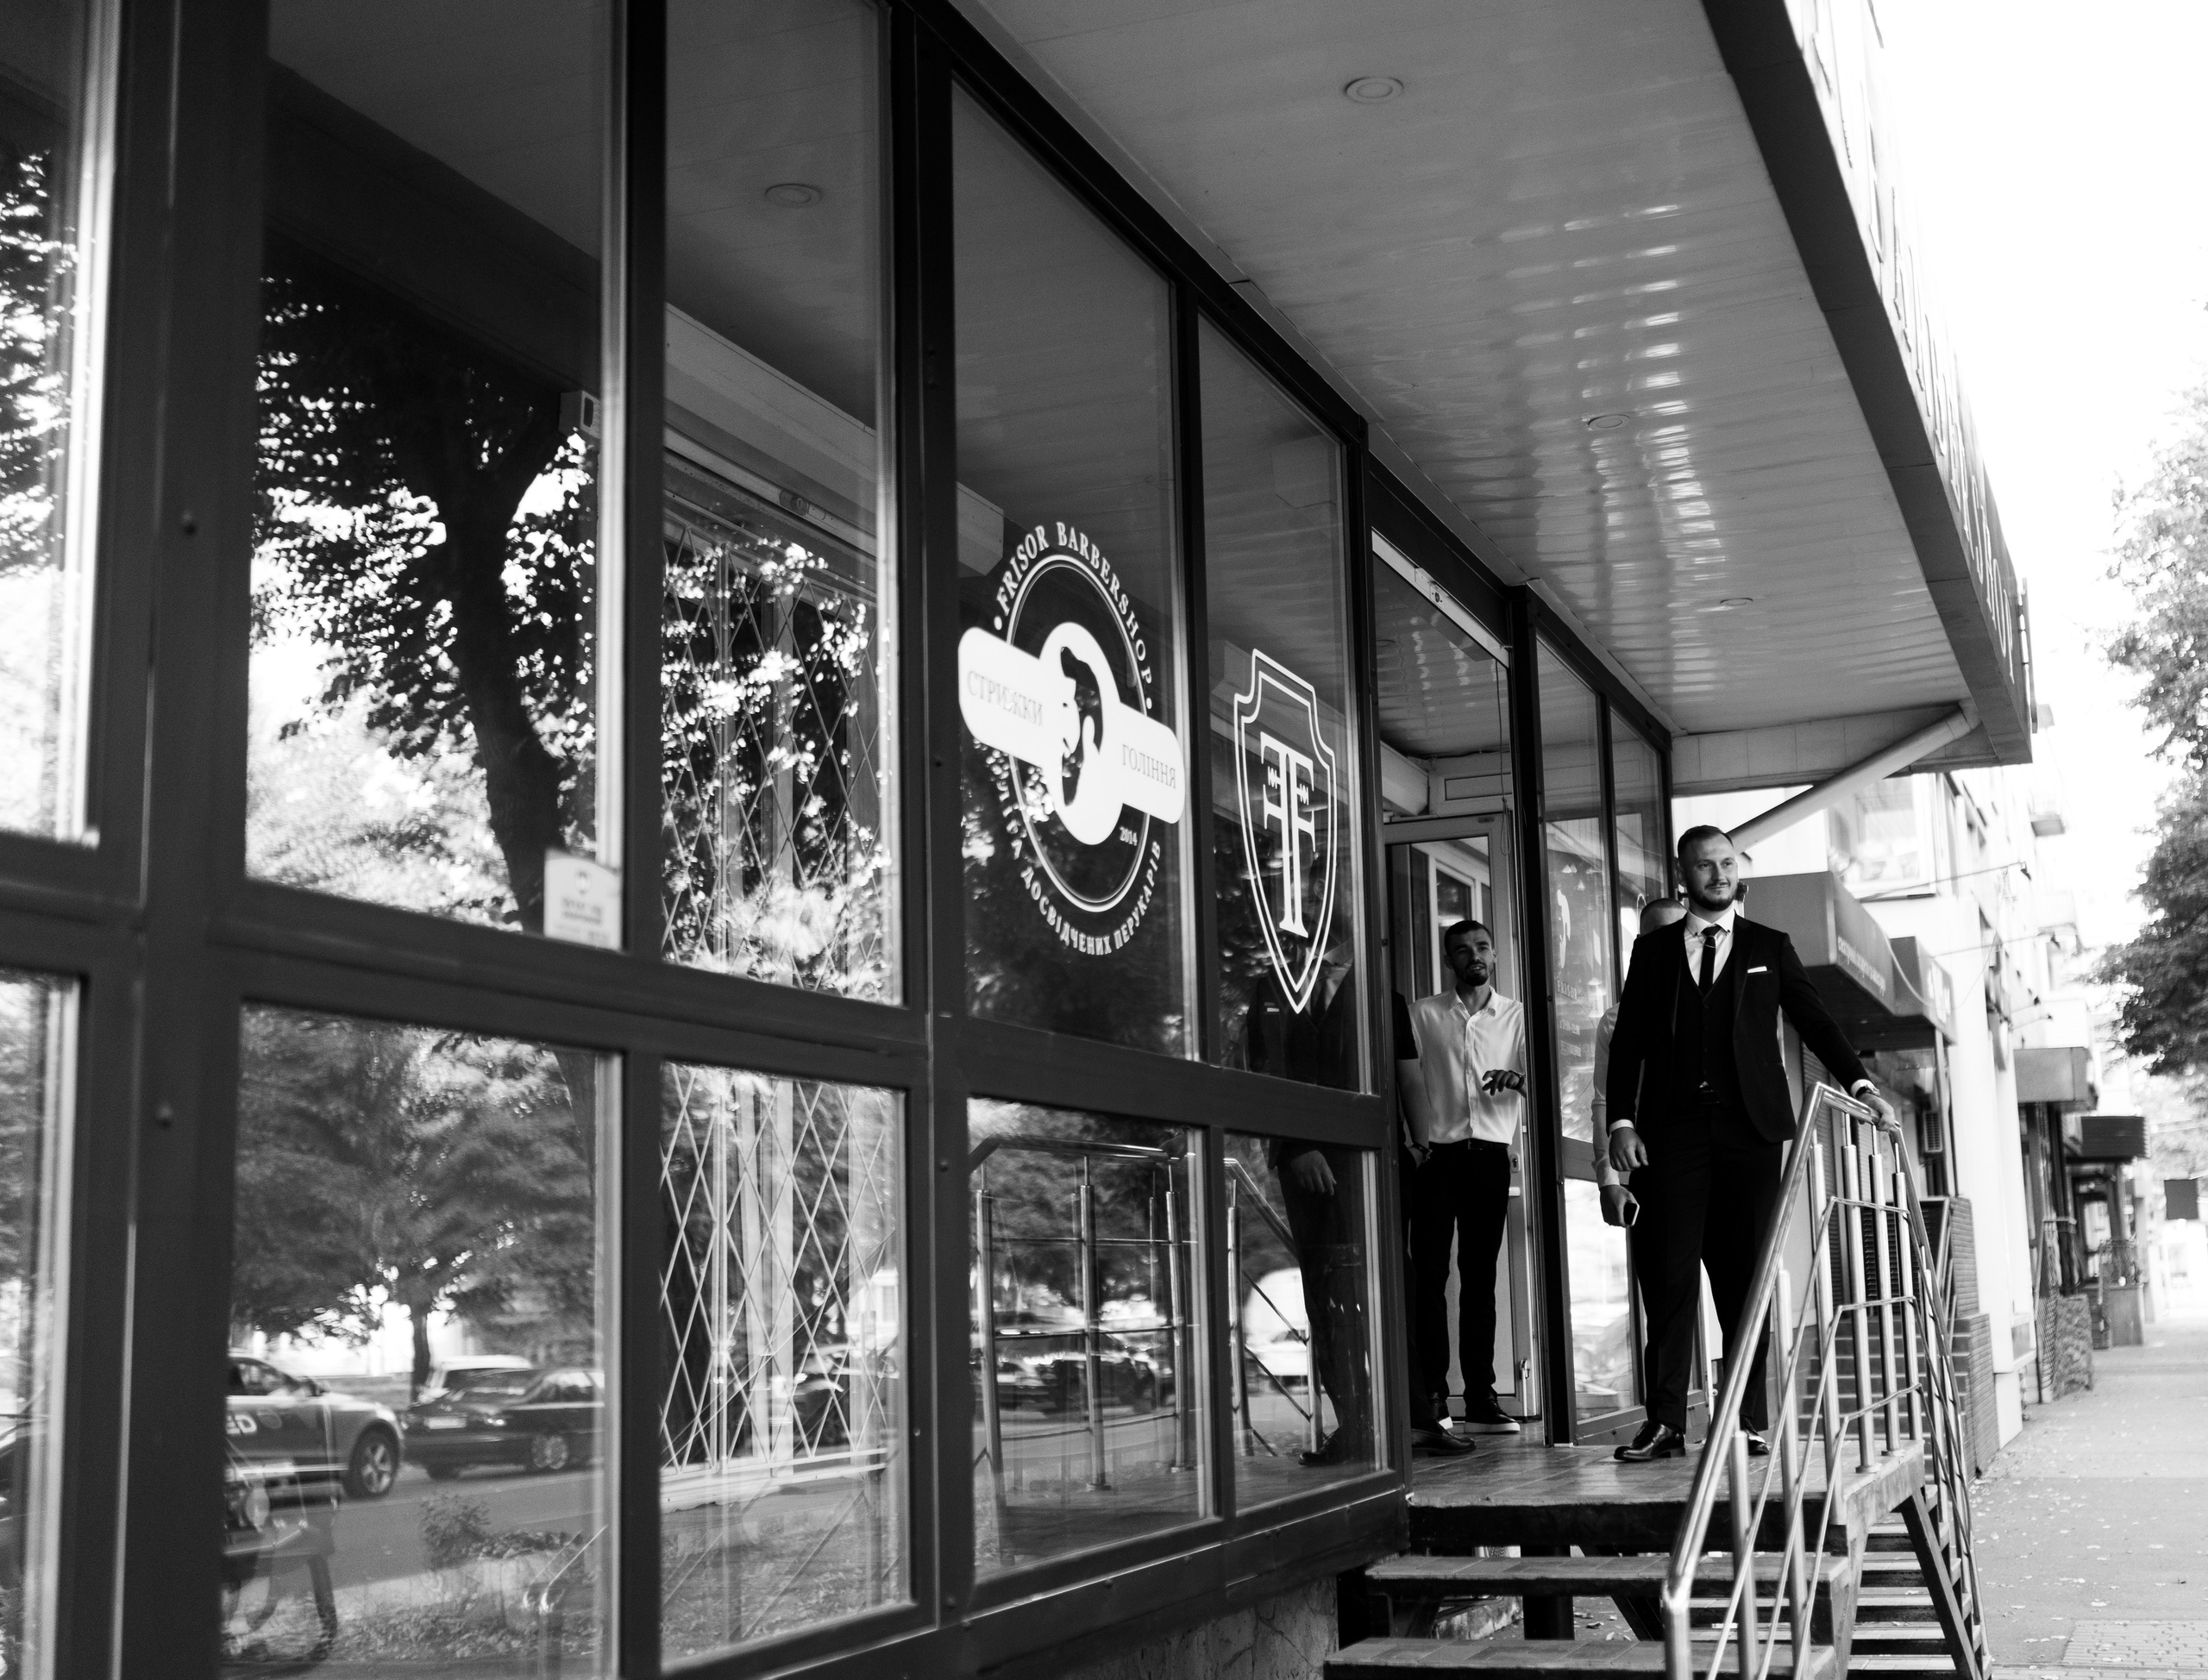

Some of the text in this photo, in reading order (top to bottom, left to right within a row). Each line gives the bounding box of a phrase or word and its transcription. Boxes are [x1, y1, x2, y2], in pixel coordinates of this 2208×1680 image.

[995, 521, 1153, 685] FRISOR BARBERSHOP
[1121, 743, 1176, 789] ГОЛІННЯ
[1119, 826, 1138, 847] 2014
[1019, 865, 1113, 956] ДОСВІДЧЕНИХ
[1113, 840, 1162, 950] ПЕРУКАРІВ
